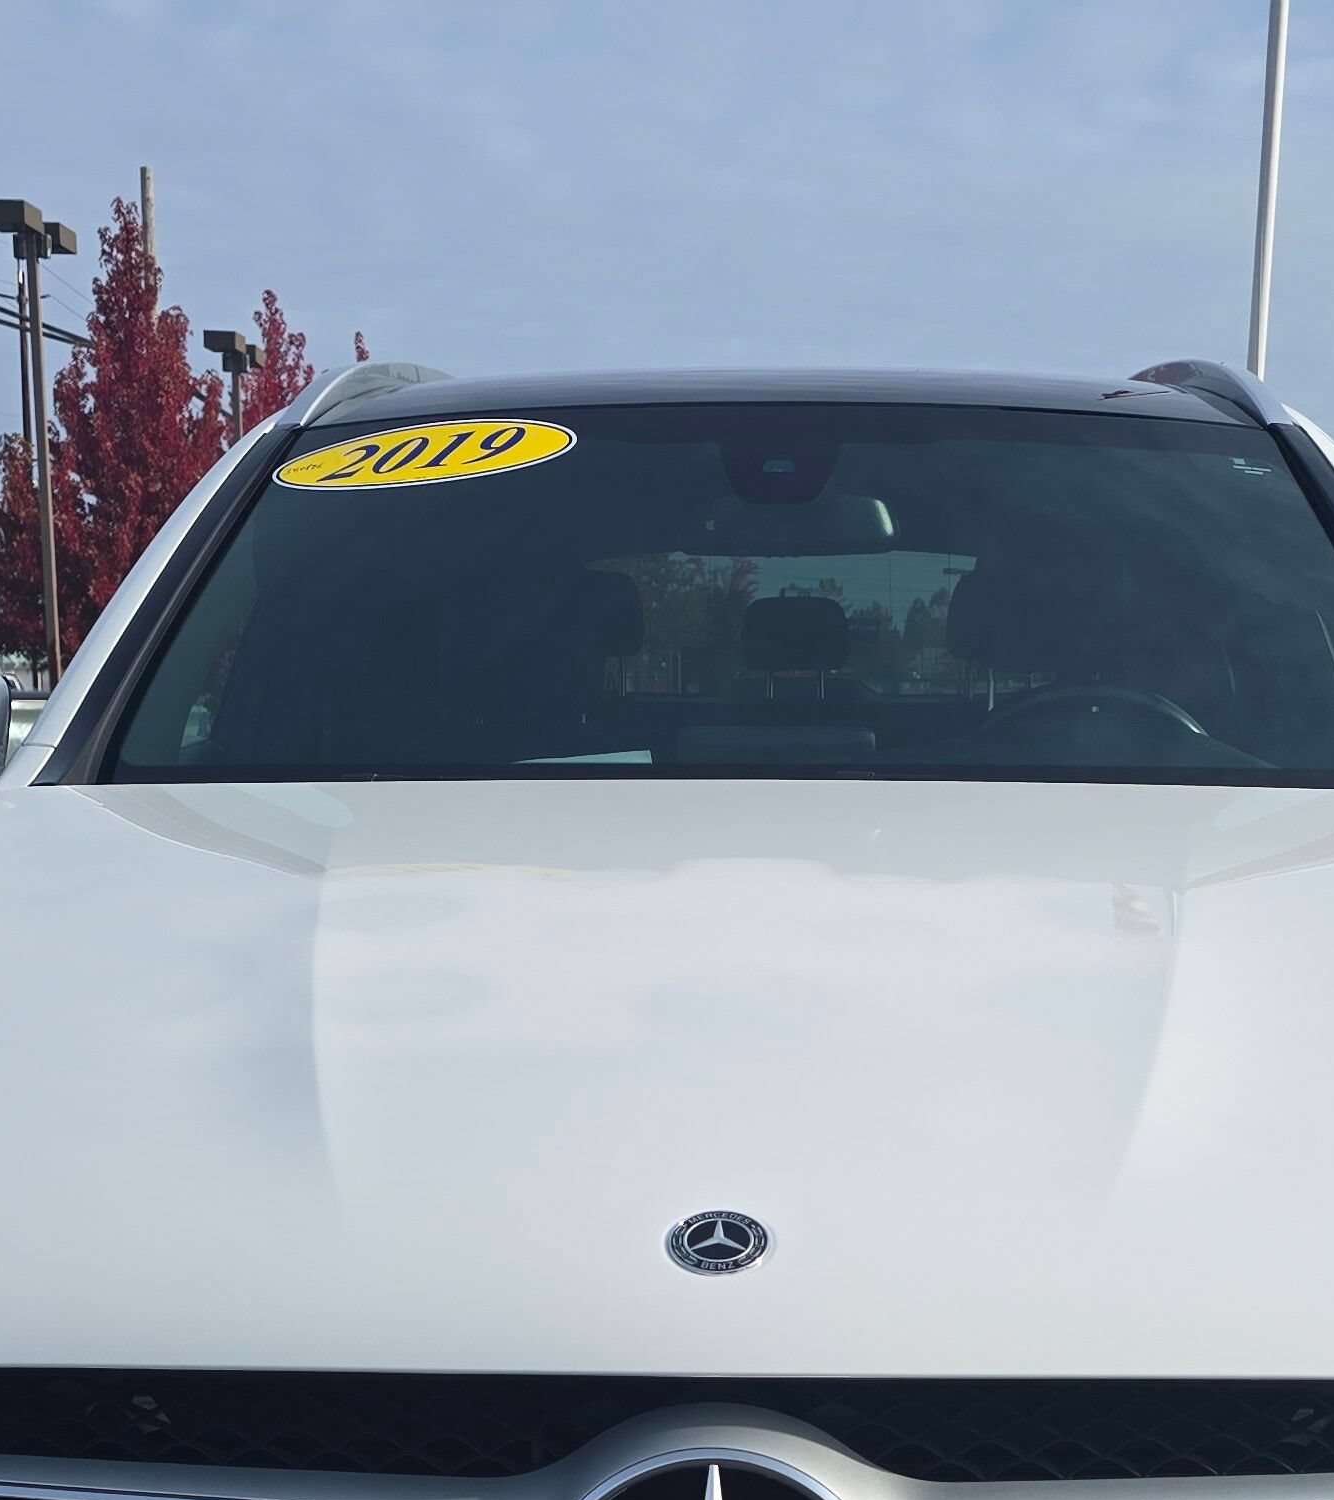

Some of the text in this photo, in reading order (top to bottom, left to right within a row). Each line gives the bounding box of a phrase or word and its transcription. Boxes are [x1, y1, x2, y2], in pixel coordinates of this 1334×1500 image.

[316, 426, 527, 482] 2019
[689, 1212, 751, 1224] MERCEDES
[700, 1260, 737, 1271] BENZ
